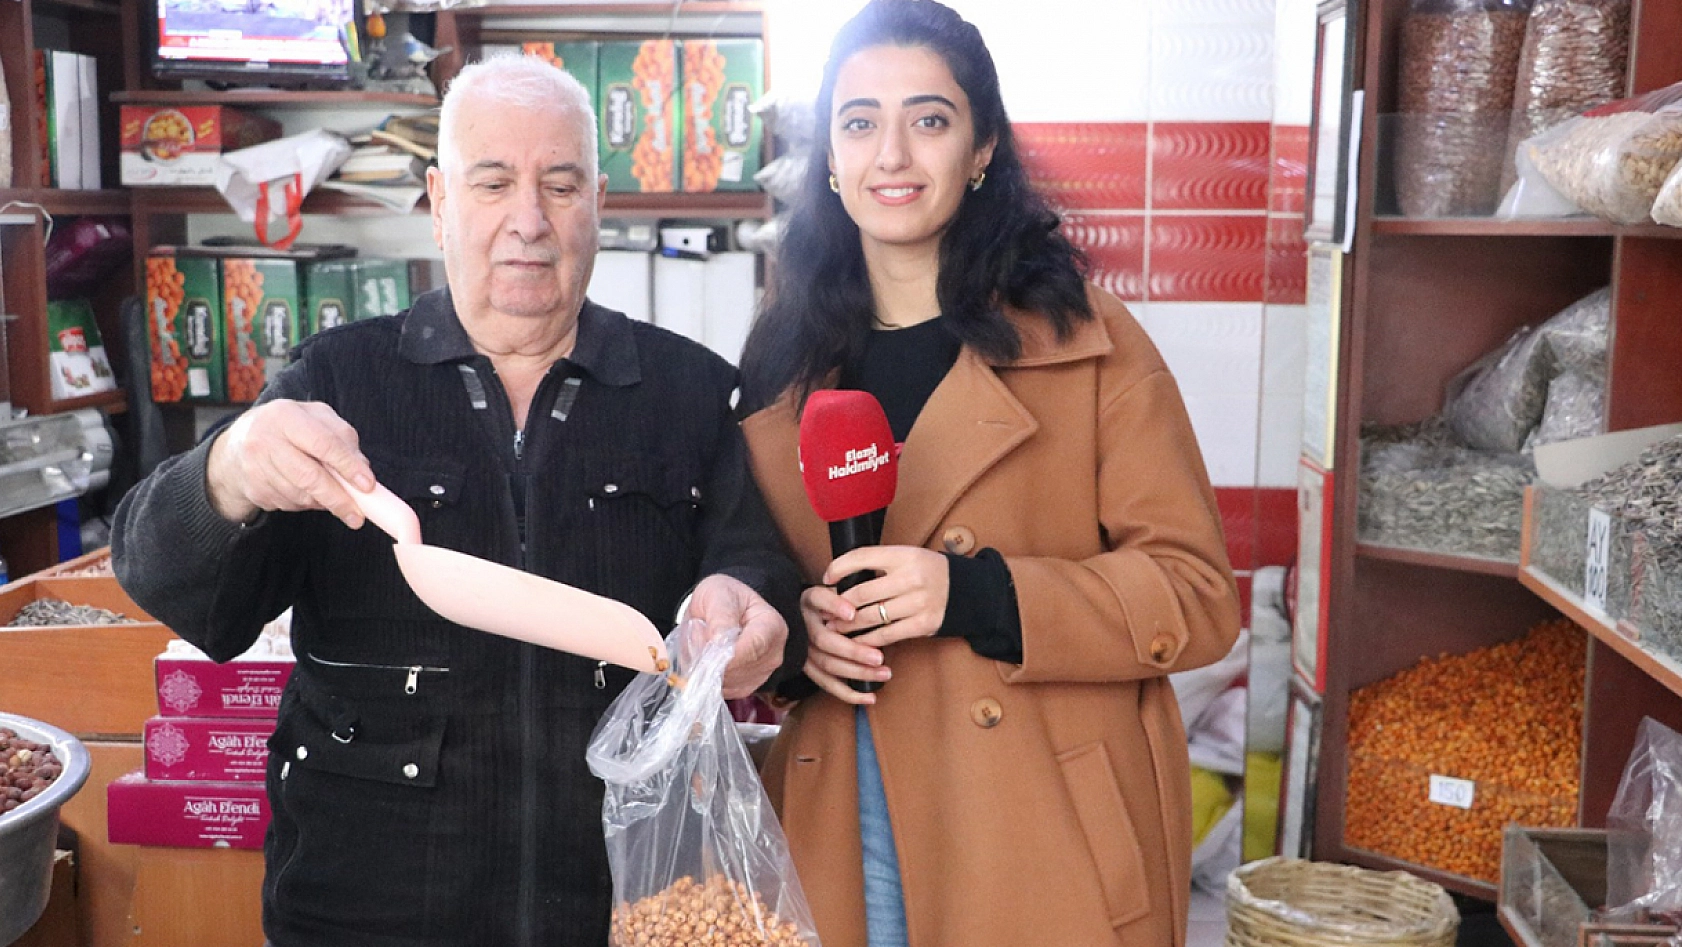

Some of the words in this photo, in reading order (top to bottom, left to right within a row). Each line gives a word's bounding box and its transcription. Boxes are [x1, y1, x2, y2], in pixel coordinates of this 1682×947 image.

[829, 451, 889, 479] Hakimiyet
[1590, 519, 1606, 563] AY
[1438, 781, 1468, 803] 150
[219, 800, 260, 815] Efendi
